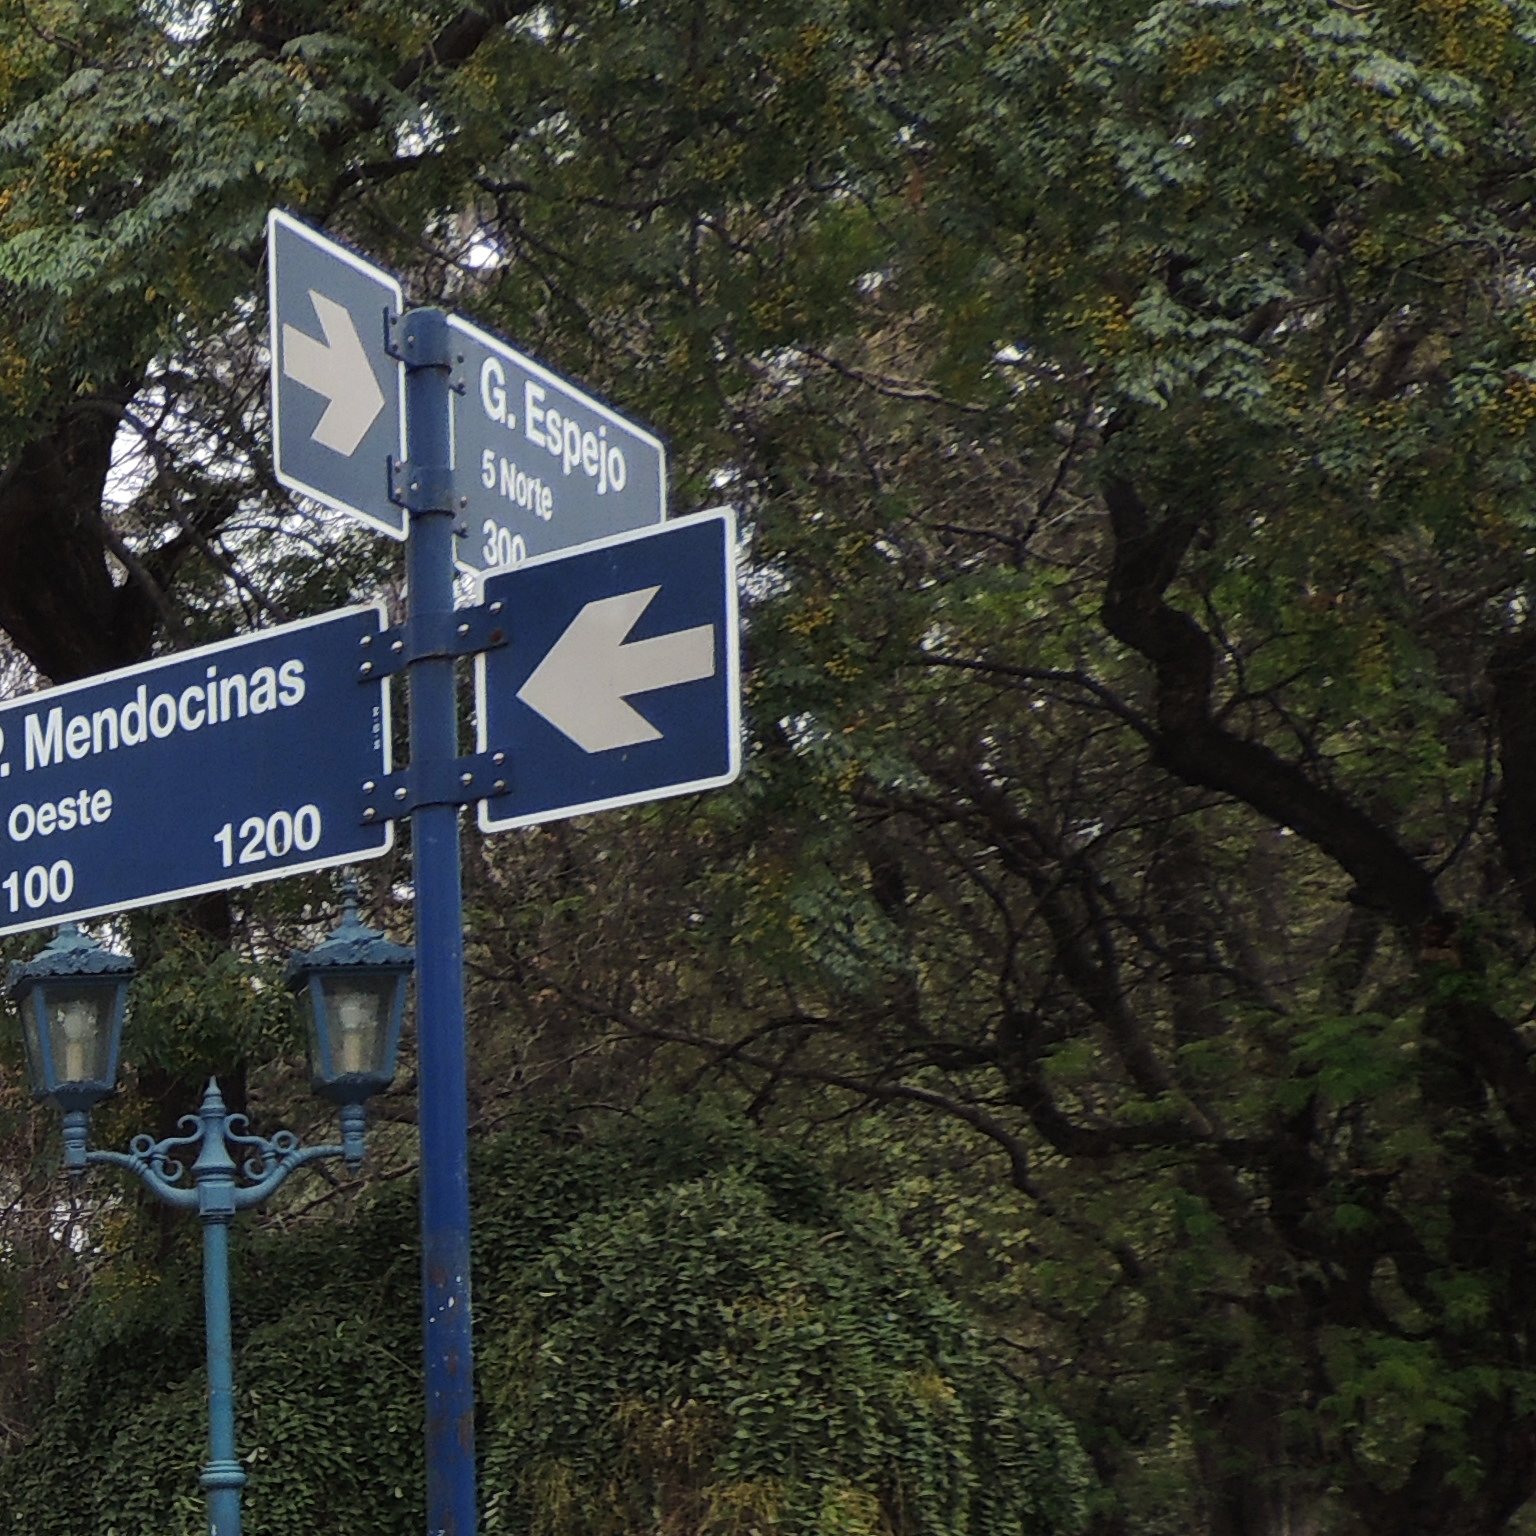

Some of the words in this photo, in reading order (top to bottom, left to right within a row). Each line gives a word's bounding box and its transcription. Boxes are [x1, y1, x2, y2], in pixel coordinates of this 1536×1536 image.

[480, 356, 516, 430] G.
[524, 380, 627, 496] Espejo
[481, 448, 496, 489] 5
[500, 457, 553, 521] Norte
[482, 518, 526, 568] 300
[25, 658, 307, 771] Mendocinas
[8, 788, 113, 842] Oeste
[213, 804, 322, 867] 1200
